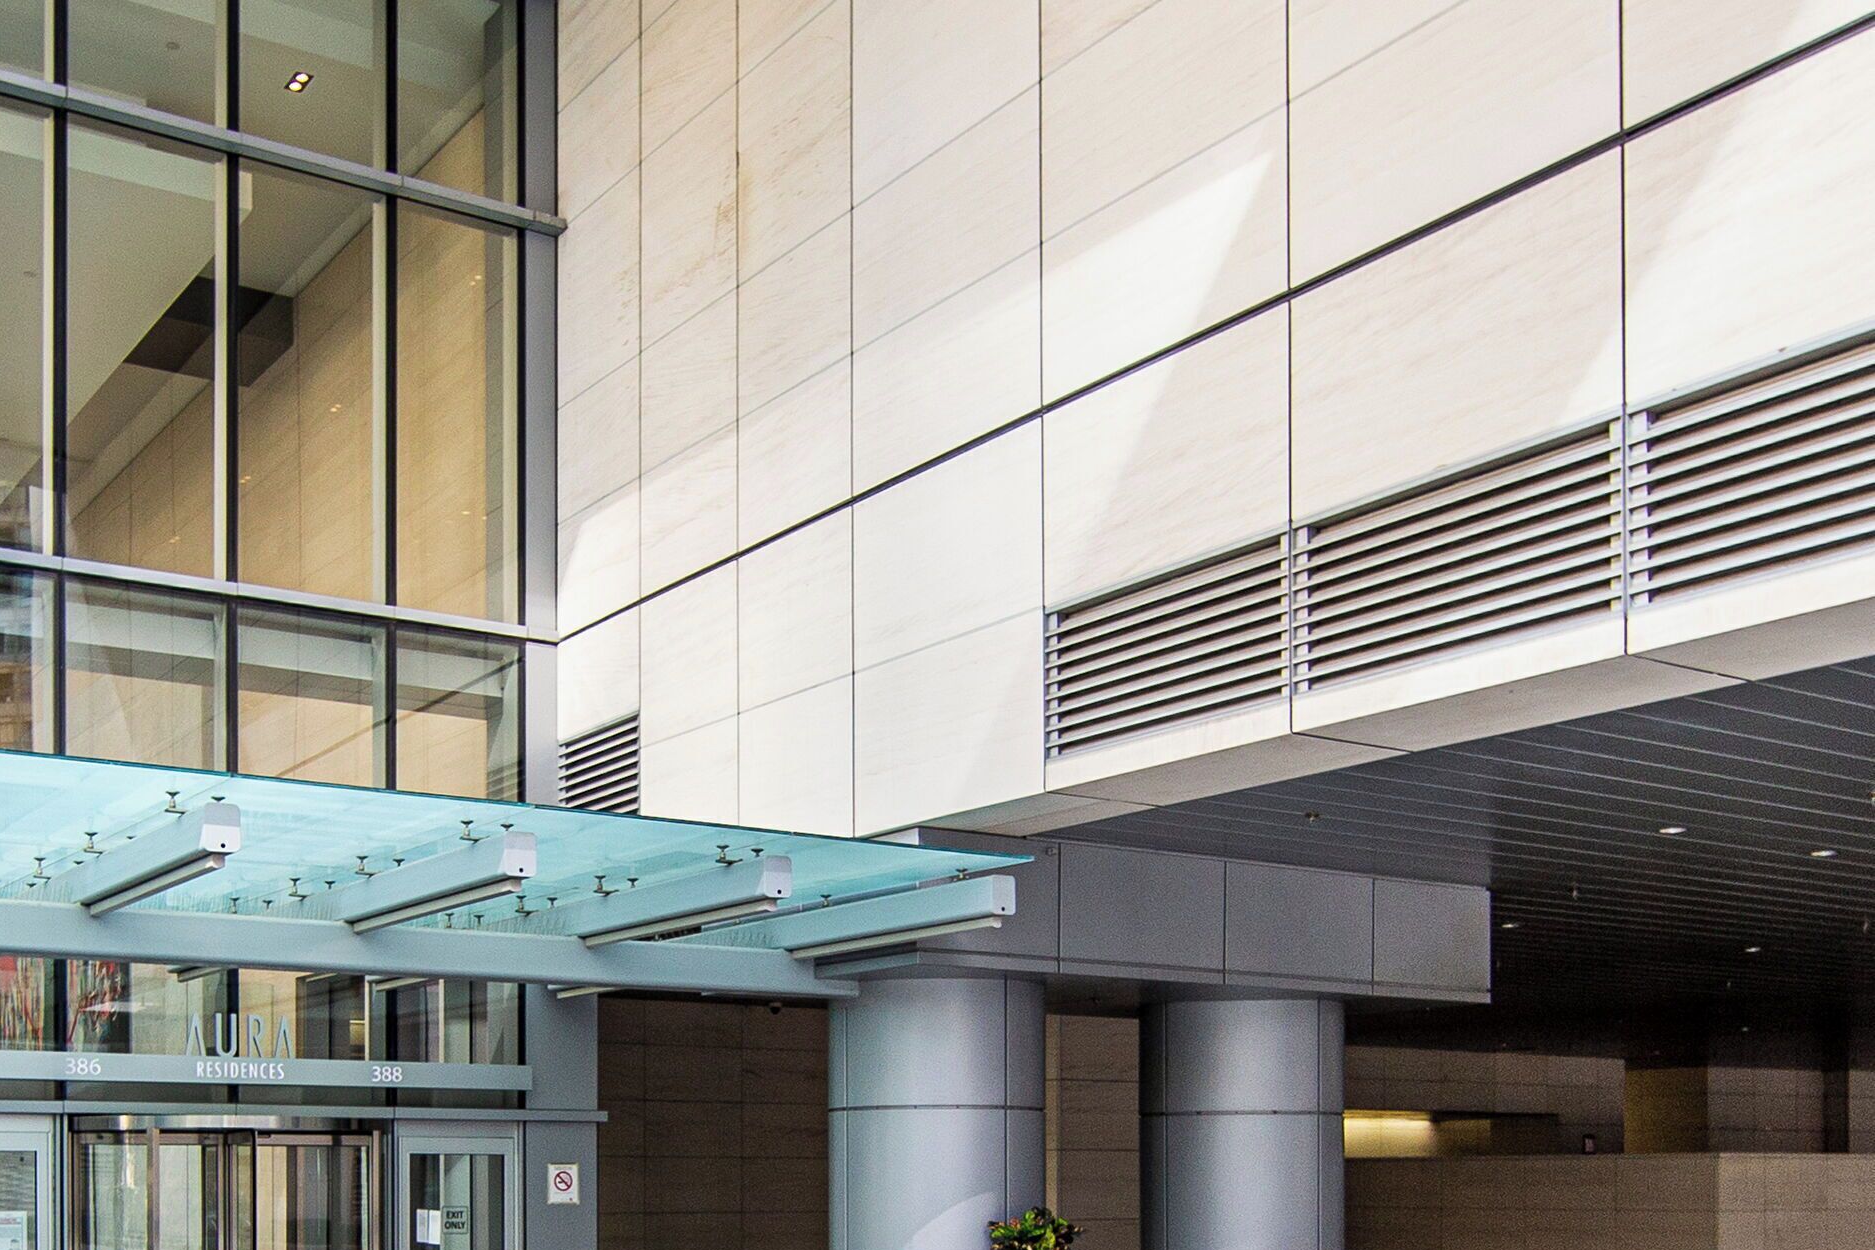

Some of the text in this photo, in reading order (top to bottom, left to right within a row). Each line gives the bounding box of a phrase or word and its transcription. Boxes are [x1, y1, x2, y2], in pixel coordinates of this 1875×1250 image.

[186, 1010, 295, 1058] AURA
[65, 1058, 101, 1075] 386
[197, 1061, 285, 1079] RESIDENCES
[372, 1066, 402, 1082] 388
[446, 1210, 464, 1219] EXIT
[444, 1221, 465, 1229] ONLY
